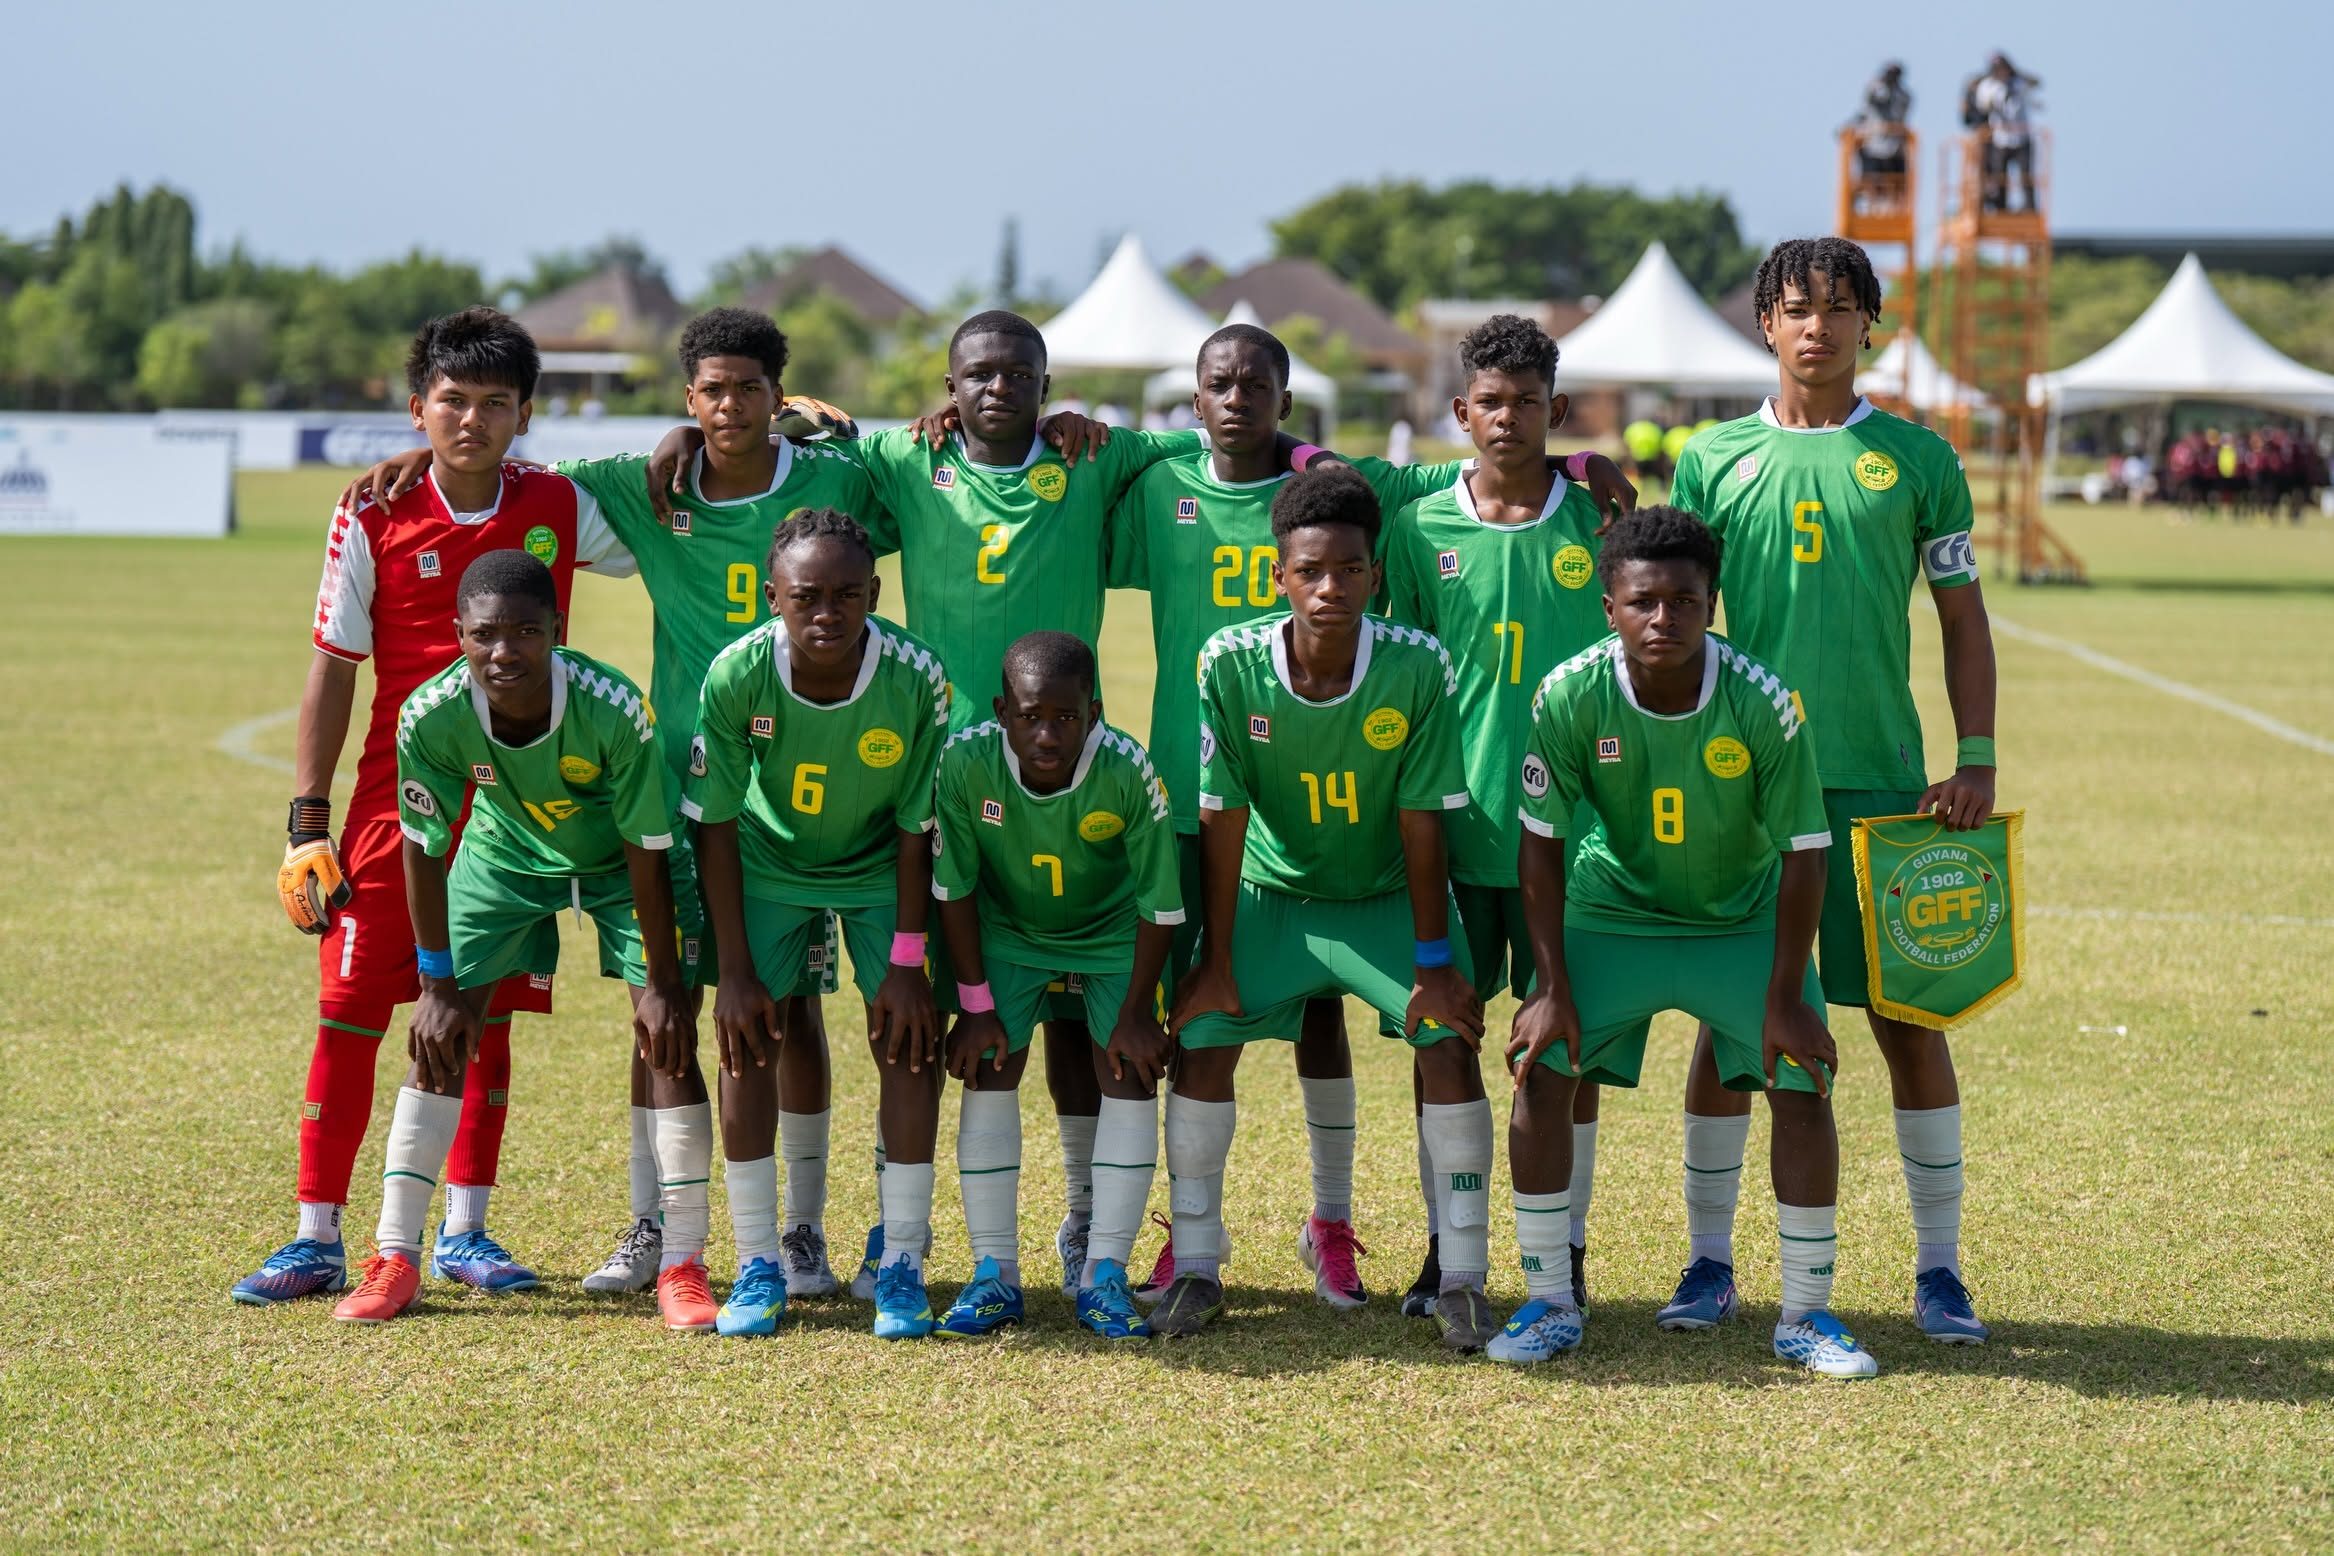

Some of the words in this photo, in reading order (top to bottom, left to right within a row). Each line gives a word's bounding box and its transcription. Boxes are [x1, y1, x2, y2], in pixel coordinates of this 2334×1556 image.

[1038, 475, 1060, 487] GFF
[1864, 464, 1889, 477] GFF
[1793, 501, 1823, 563] 5
[977, 525, 1010, 584] 2
[1213, 545, 1279, 607] 20
[1562, 561, 1586, 573] GFF
[726, 563, 757, 623] 9
[1373, 723, 1398, 735] GFF
[868, 742, 893, 753] GFF
[1715, 752, 1740, 764] GFF
[567, 766, 594, 775] GFF
[1524, 764, 1545, 788] CFU
[404, 787, 431, 810] CFU
[792, 763, 827, 815] 6
[1300, 771, 1359, 824] 14
[1653, 787, 1684, 844] 8
[1088, 823, 1114, 833] GFF
[1913, 849, 1968, 870] GUYANA
[1032, 854, 1063, 897] 7
[1920, 871, 1964, 890] 1902
[1907, 886, 1982, 928] GFF
[1890, 919, 1940, 964] FOOTBALL
[1944, 903, 1999, 964] FEDERATION
[340, 916, 357, 977] 1
